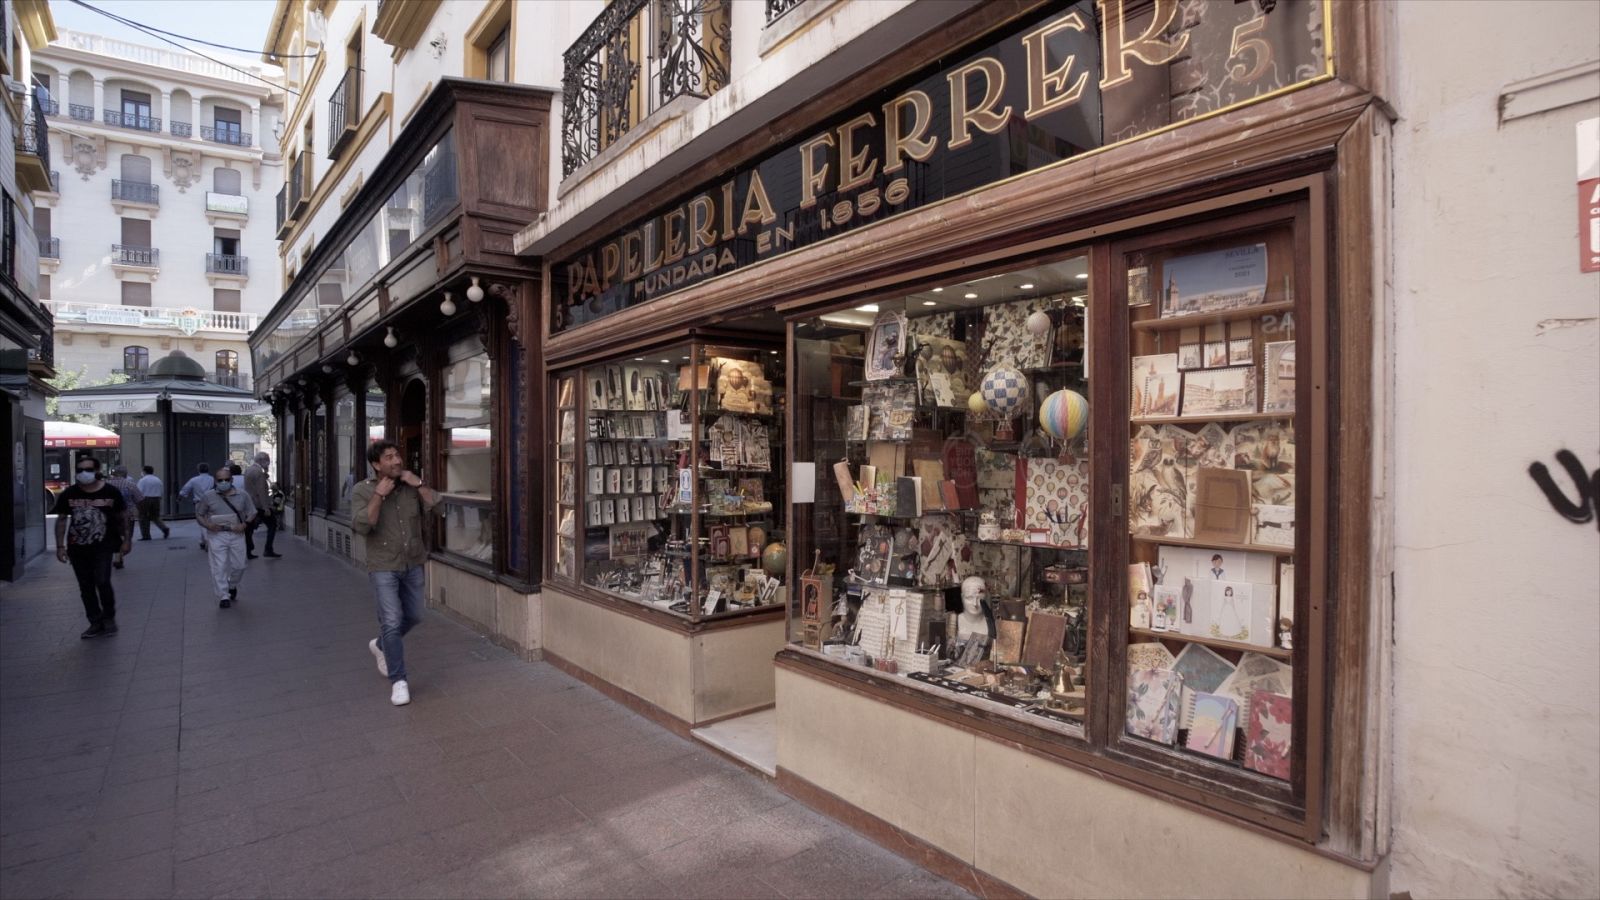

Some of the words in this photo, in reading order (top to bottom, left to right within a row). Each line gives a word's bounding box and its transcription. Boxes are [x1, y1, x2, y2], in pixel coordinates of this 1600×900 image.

[1228, 16, 1276, 83] 5
[567, 169, 776, 306] PAPELERIA
[799, 0, 1191, 208] FERRER
[634, 247, 737, 298] FUNDADA
[756, 221, 795, 254] EN
[119, 400, 137, 409] ABC
[195, 400, 214, 409] ABC
[239, 402, 257, 411] ABC
[122, 420, 163, 428] PRENSA
[182, 420, 226, 428] PRENSA
